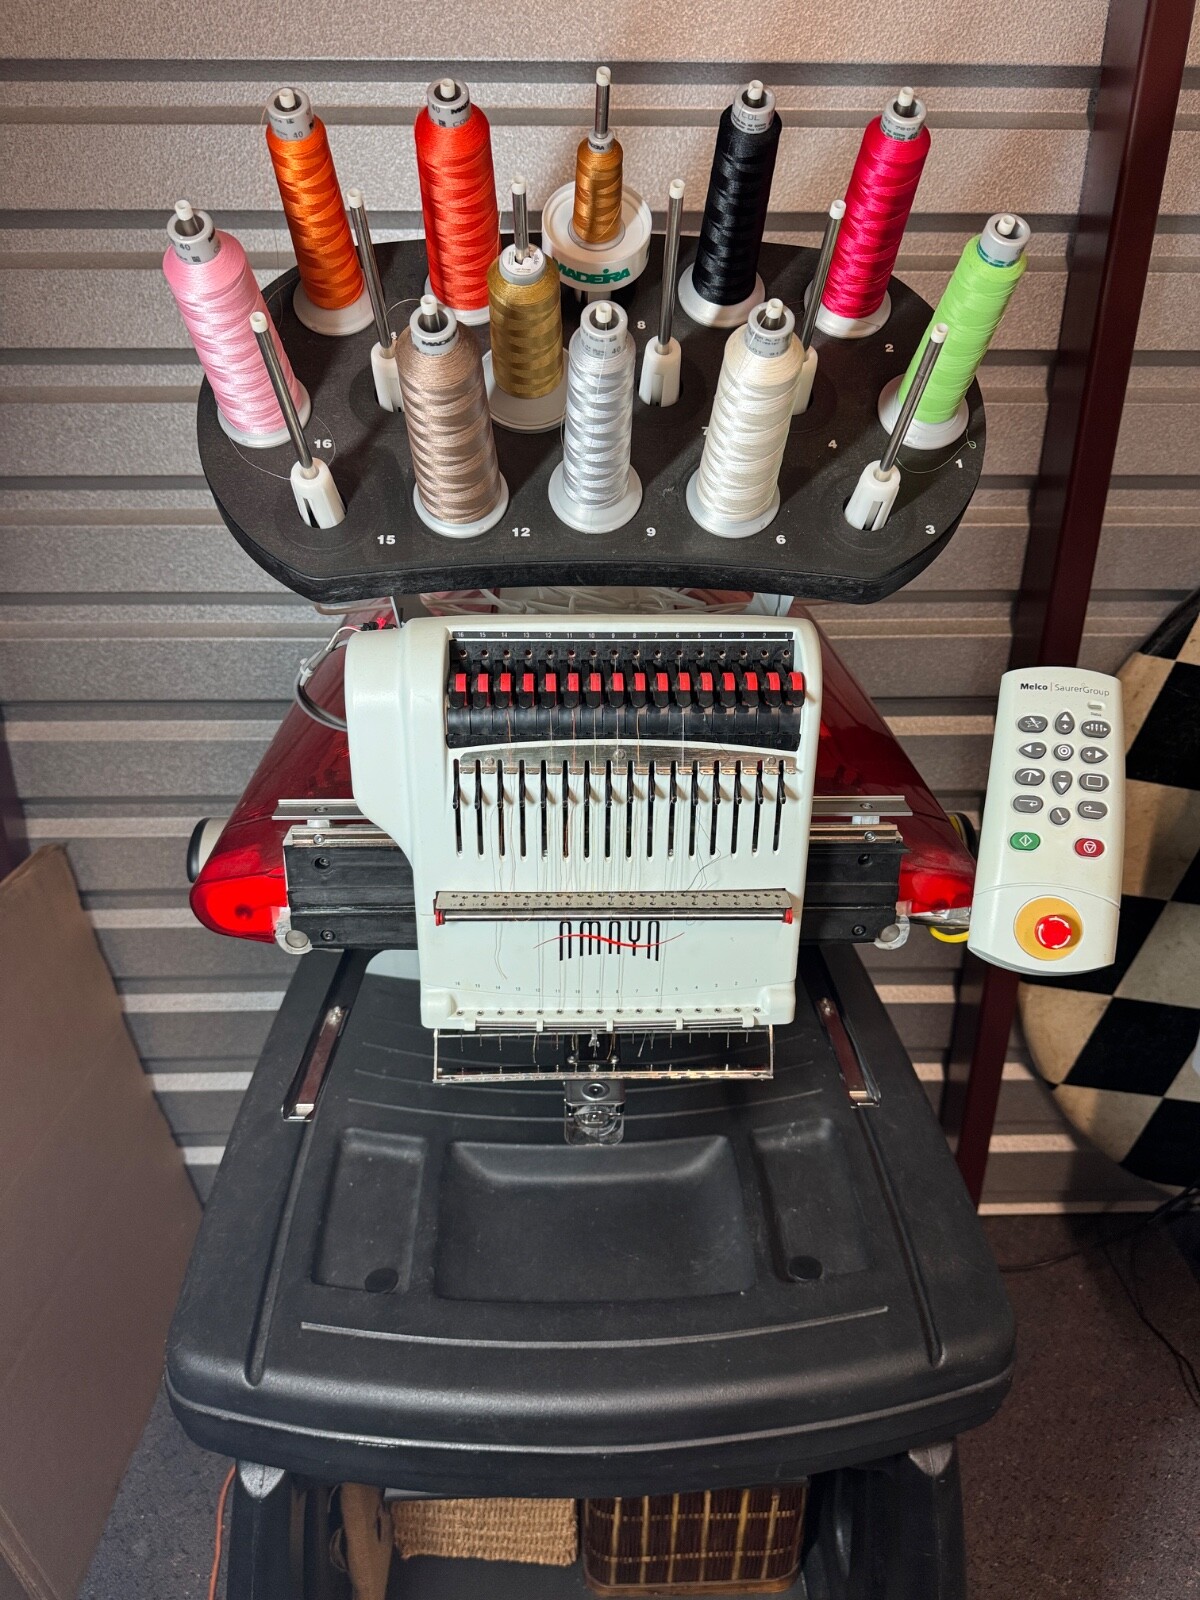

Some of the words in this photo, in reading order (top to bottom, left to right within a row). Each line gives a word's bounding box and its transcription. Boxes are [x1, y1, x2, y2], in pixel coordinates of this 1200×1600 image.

[637, 320, 646, 330] 8
[884, 343, 894, 352] 2
[314, 439, 332, 448] 16
[828, 440, 837, 449] 4
[955, 459, 963, 468] 1
[512, 527, 530, 537] 12
[646, 527, 656, 537] 9
[925, 525, 936, 535] 3
[377, 535, 396, 544] 15
[776, 534, 786, 544] 6
[1054, 683, 1110, 697] SaurerGroup
